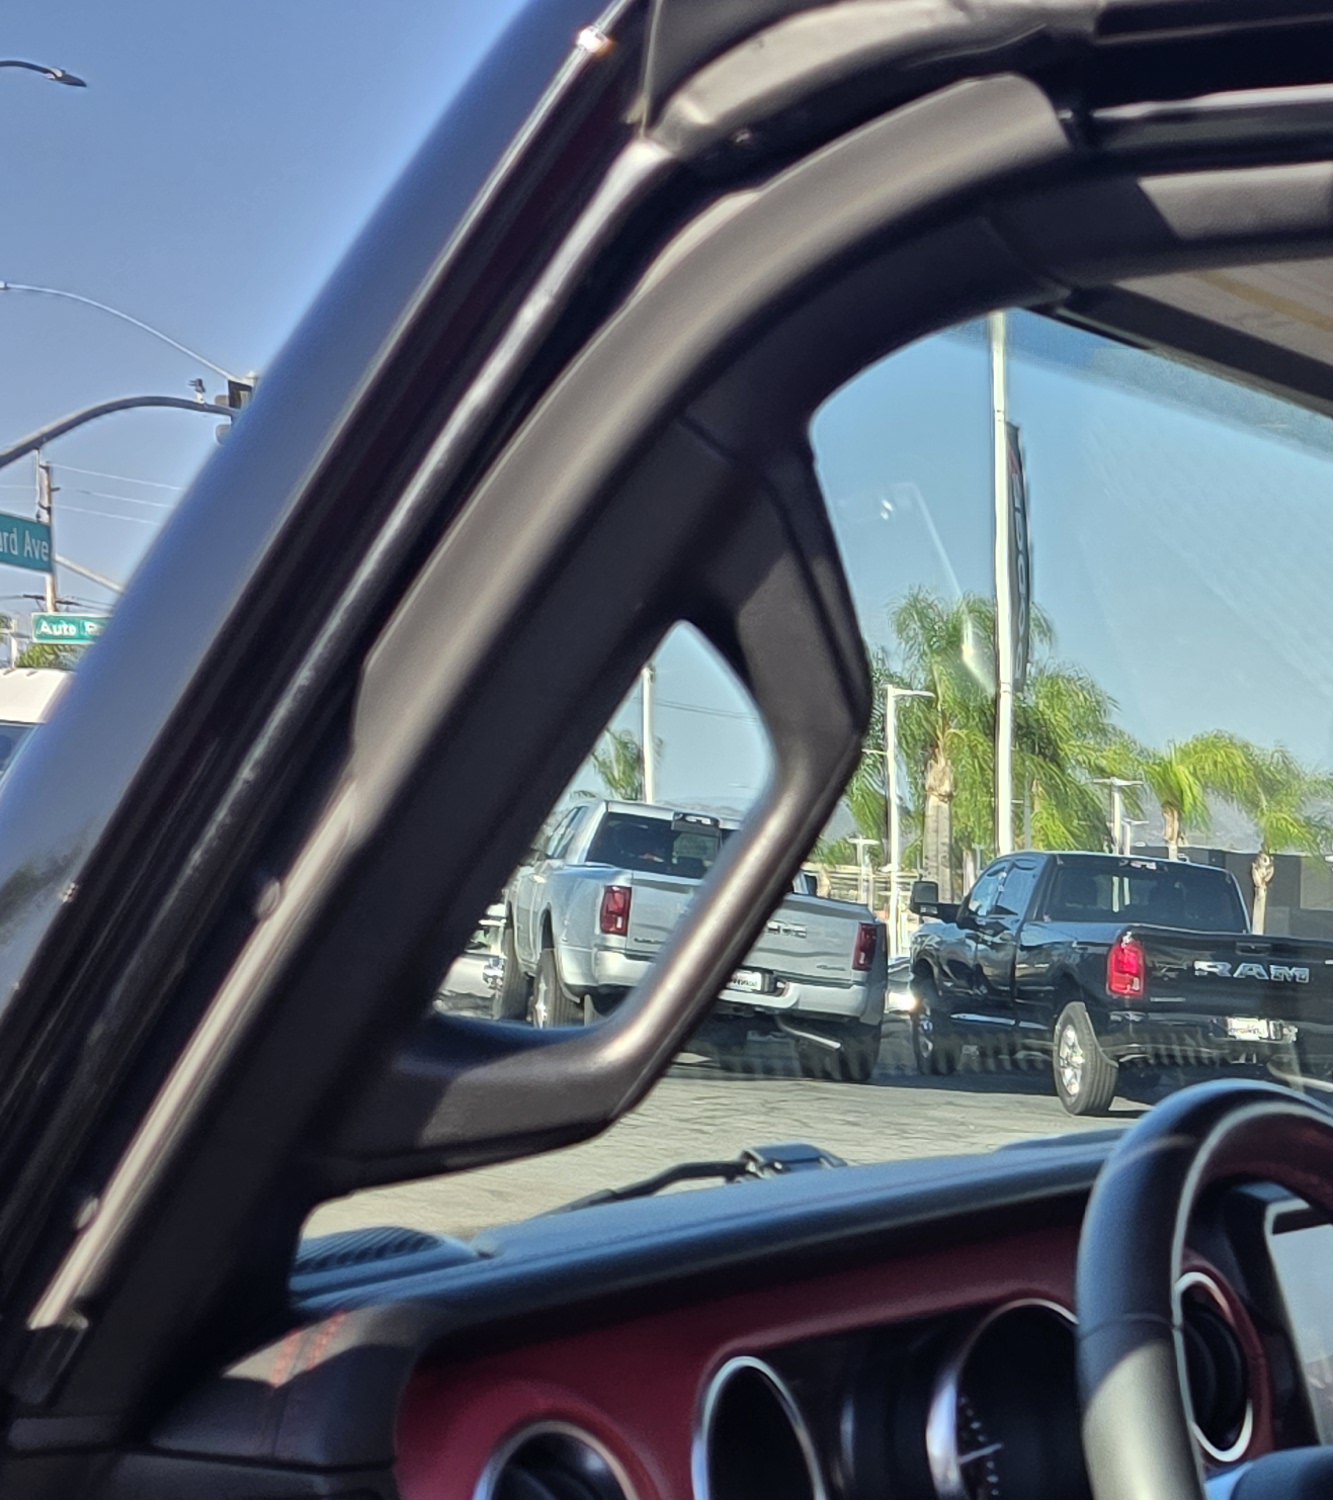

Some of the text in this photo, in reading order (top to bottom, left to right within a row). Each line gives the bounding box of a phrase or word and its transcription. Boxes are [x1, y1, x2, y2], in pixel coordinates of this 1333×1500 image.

[23, 530, 49, 562] Ave
[39, 619, 77, 636] Auto
[1193, 960, 1310, 984] RAM
